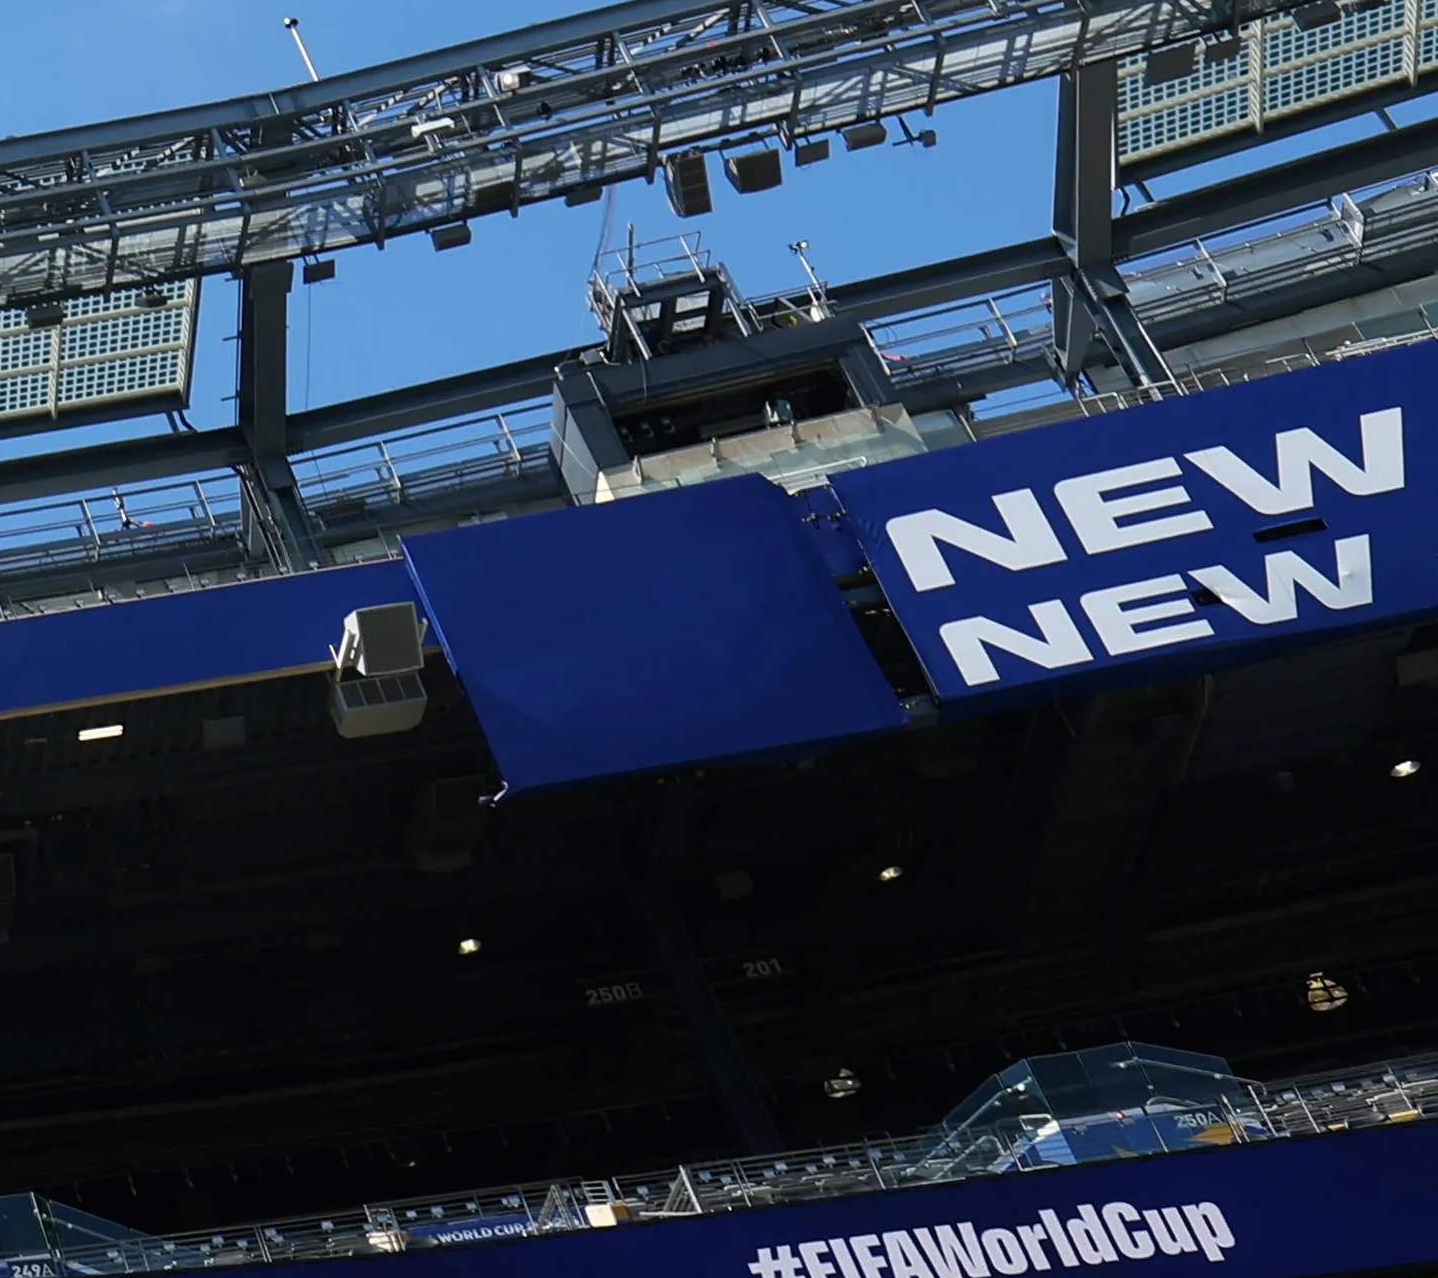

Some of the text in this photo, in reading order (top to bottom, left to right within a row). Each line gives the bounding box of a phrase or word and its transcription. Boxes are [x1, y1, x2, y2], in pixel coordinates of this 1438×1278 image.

[885, 407, 1405, 592] NEW
[938, 533, 1374, 687] NEW
[741, 957, 783, 980] 201
[585, 982, 643, 1006] 250B
[1173, 1111, 1223, 1129] 250A
[438, 1227, 492, 1243] WORLD
[10, 1263, 55, 1278] 249A
